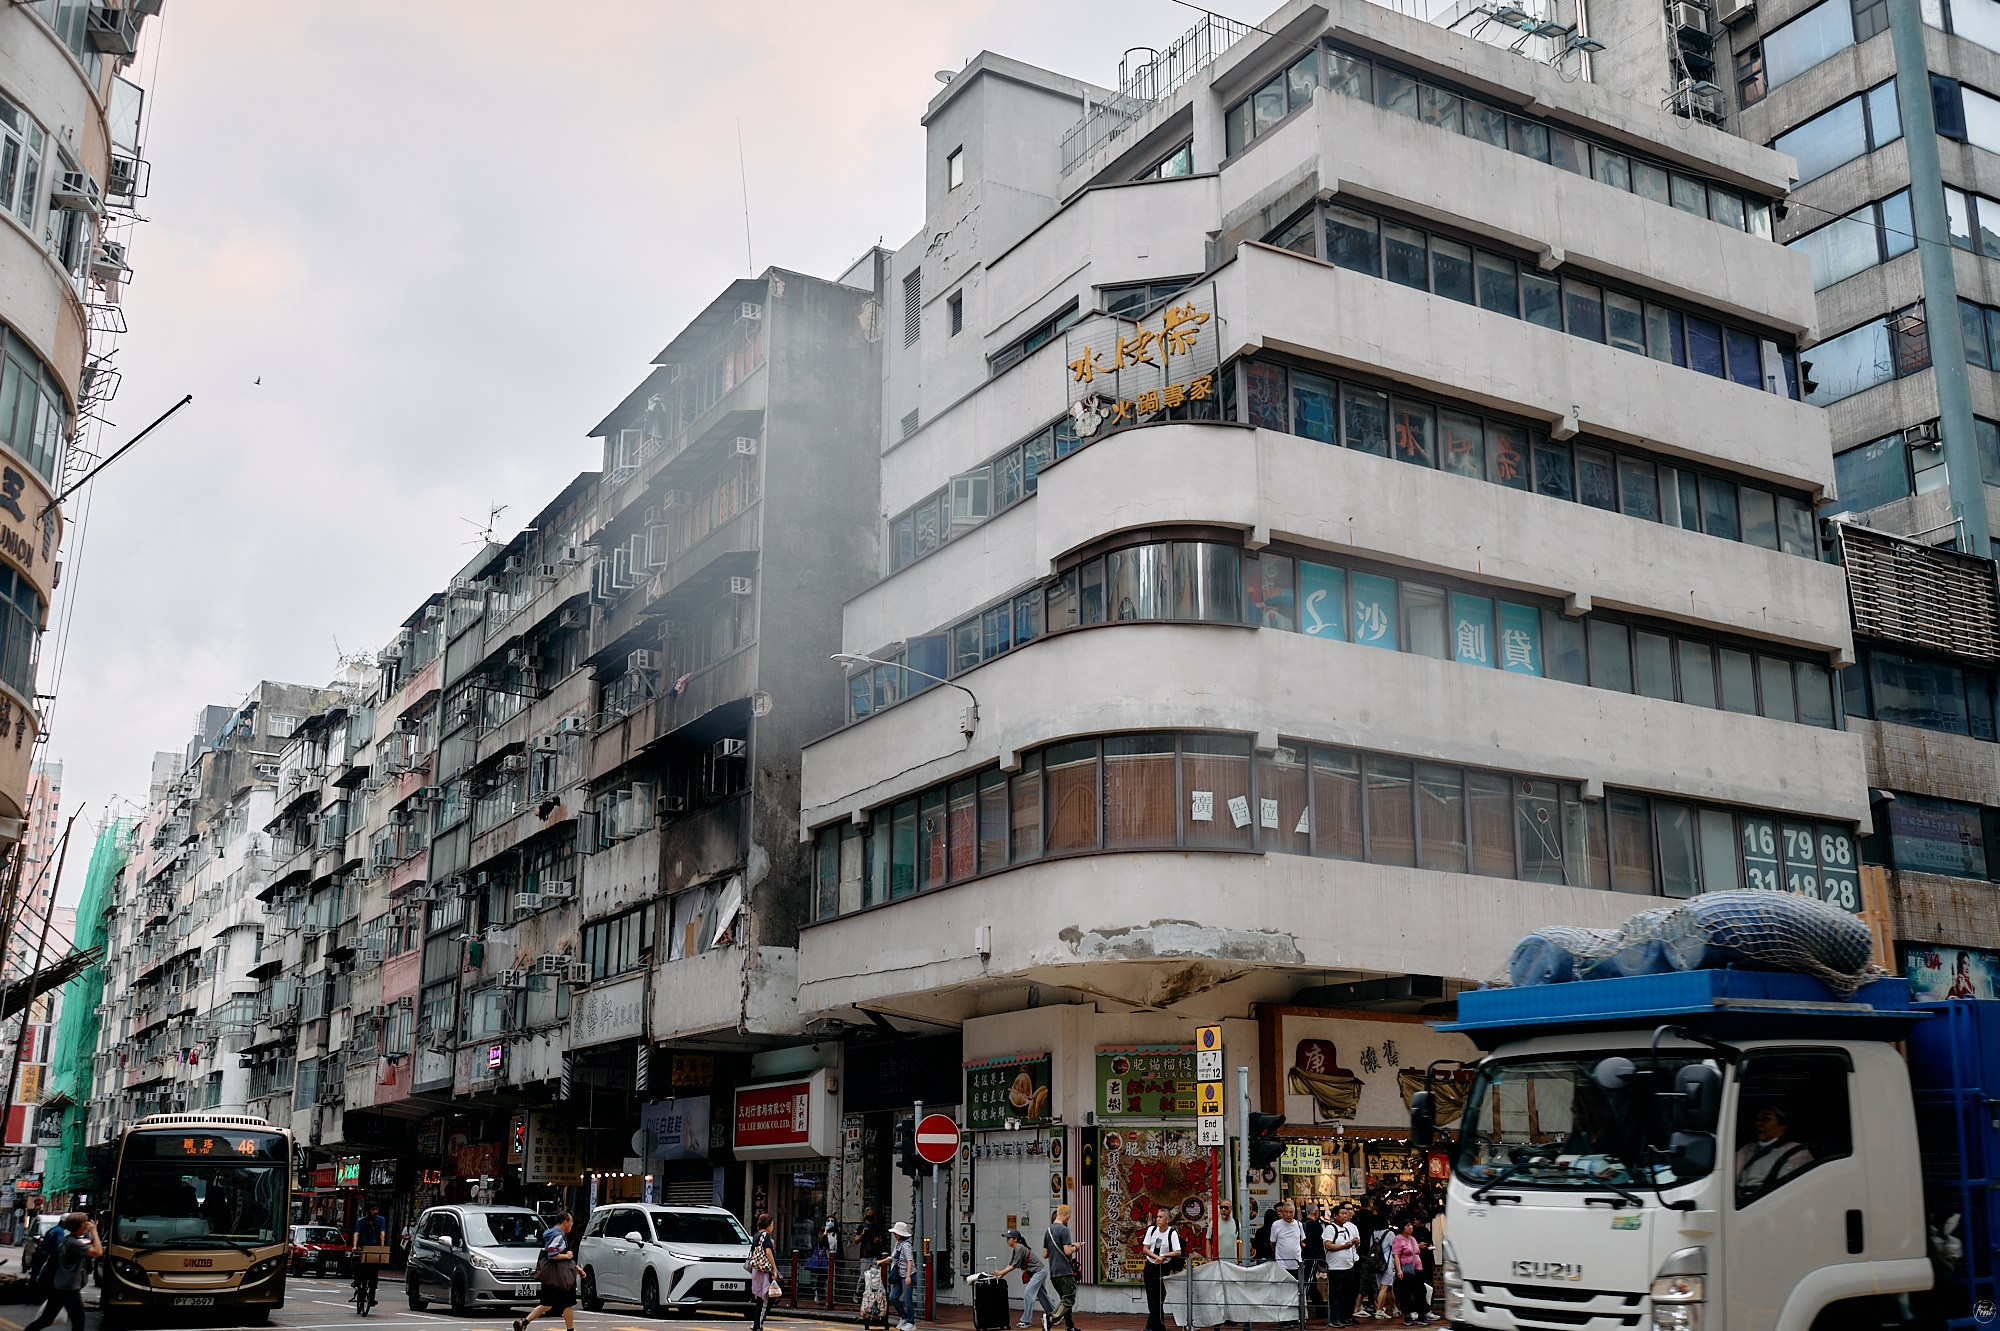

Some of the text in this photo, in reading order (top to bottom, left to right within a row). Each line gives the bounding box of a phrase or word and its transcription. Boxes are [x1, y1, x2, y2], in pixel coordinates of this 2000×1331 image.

[1112, 375, 1214, 425] 火鍋專家
[1571, 405, 1580, 419] 5
[1744, 823, 1850, 865] 16 79 68
[1749, 868, 1855, 909] 31 18 28
[1133, 1058, 1193, 1071] 肥貓榴槤
[1212, 1053, 1217, 1062] 7
[1212, 1068, 1221, 1078] 12
[1127, 1080, 1175, 1095] 貓山王
[974, 1089, 1005, 1104] 日日直送
[1108, 1081, 1121, 1110] 老樹
[738, 1101, 792, 1118] 天利行書局有限公司
[1127, 1096, 1175, 1112] 黑刺
[973, 1106, 1005, 1121] 保證新鮮
[757, 1121, 770, 1130] BOOK
[1204, 1120, 1217, 1128] End
[1203, 1131, 1218, 1142] 終止
[238, 1139, 255, 1155] 46
[1300, 1147, 1321, 1158] 貓山王
[1512, 1260, 1583, 1281] ISUZU
[720, 1282, 738, 1290] 6889
